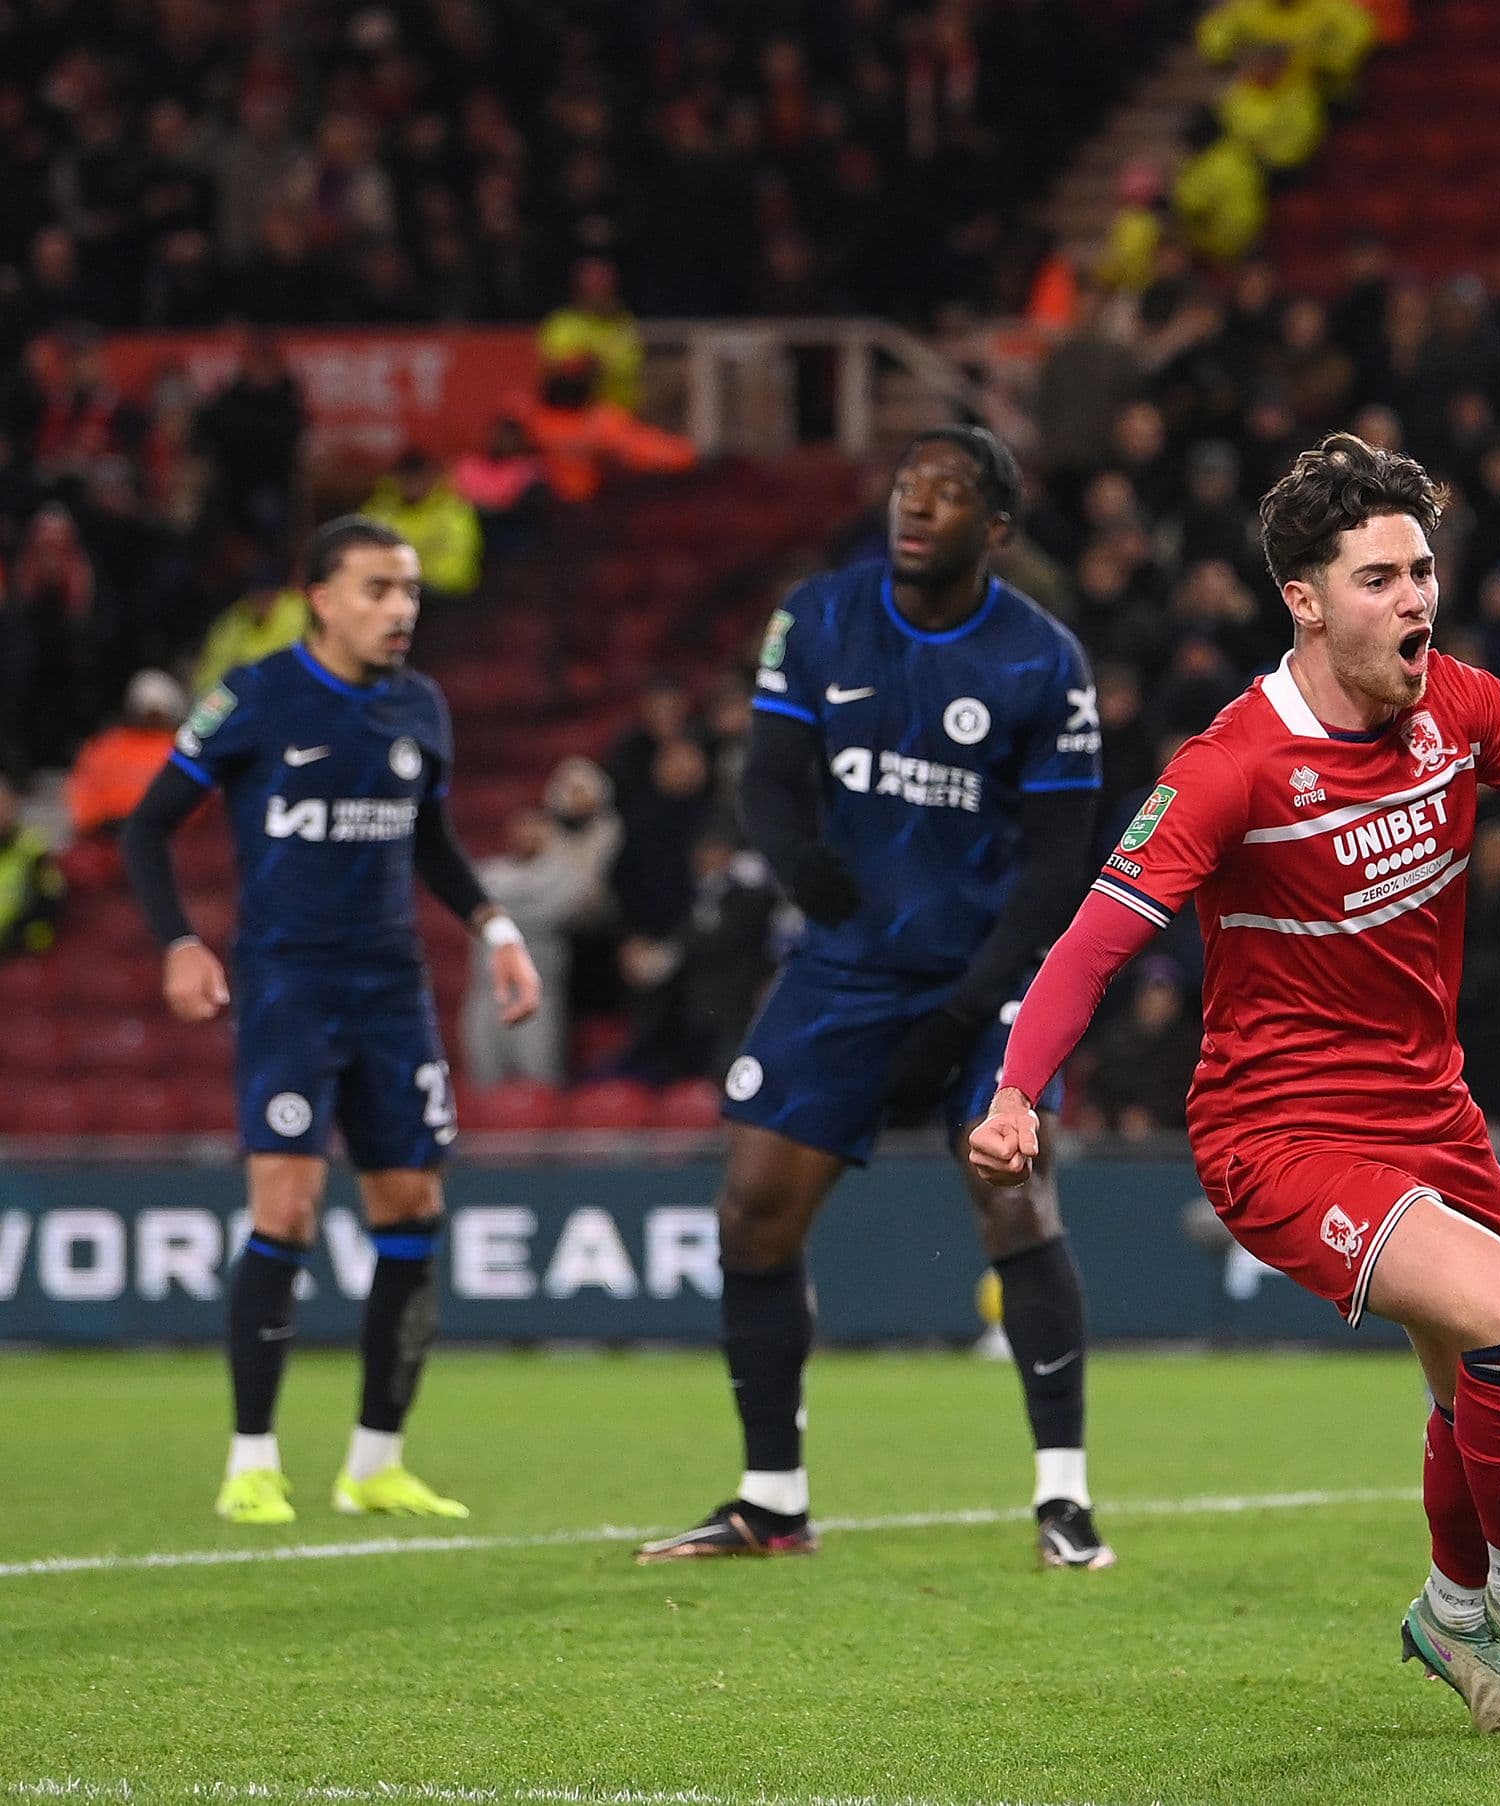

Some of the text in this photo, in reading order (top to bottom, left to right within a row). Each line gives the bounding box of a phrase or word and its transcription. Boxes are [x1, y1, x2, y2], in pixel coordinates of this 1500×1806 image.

[1333, 790, 1447, 866] UNIBET
[1361, 880, 1399, 903] ZERO%
[0, 1207, 724, 1300] OREAR
